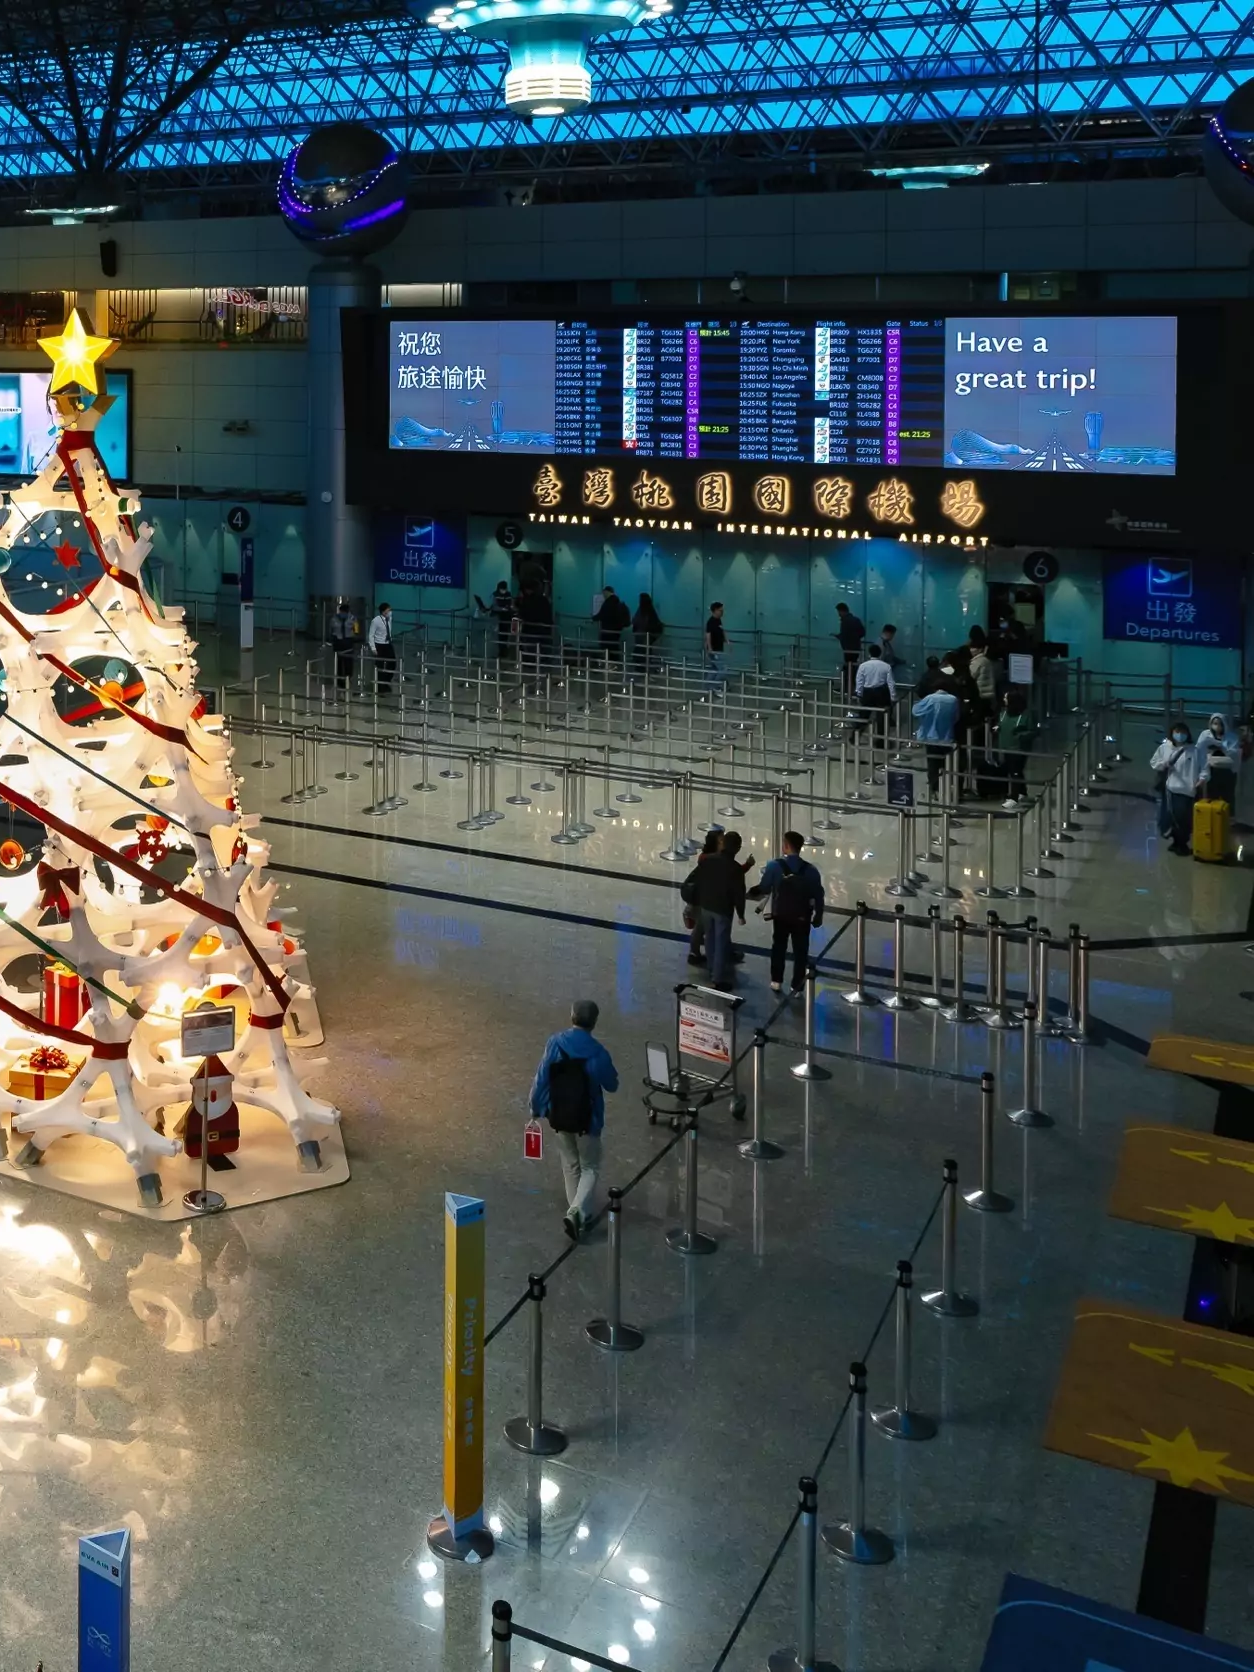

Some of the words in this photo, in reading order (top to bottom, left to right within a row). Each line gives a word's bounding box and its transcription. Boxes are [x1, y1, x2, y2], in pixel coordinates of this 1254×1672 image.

[886, 320, 901, 328] Gate
[398, 331, 442, 356] 祝您
[956, 332, 1023, 352] Have
[1033, 336, 1048, 352] a
[397, 365, 487, 390] 旅途愉快
[954, 369, 1027, 396] great
[1036, 368, 1096, 396] trip!
[532, 465, 985, 528] 臺灣桃園國際機場
[232, 512, 243, 528] 4
[529, 513, 591, 525] TAIWAN
[614, 517, 693, 531] TAOYUAN
[717, 523, 872, 541] INTERNATIONAL
[898, 532, 989, 547] AIRPORT
[503, 526, 515, 544] 5
[403, 551, 437, 570] 出發
[1034, 558, 1047, 578] 6
[389, 568, 452, 584] Departures
[1146, 601, 1197, 624] 出發
[1126, 622, 1220, 642] Departures
[462, 1297, 476, 1375] Priority
